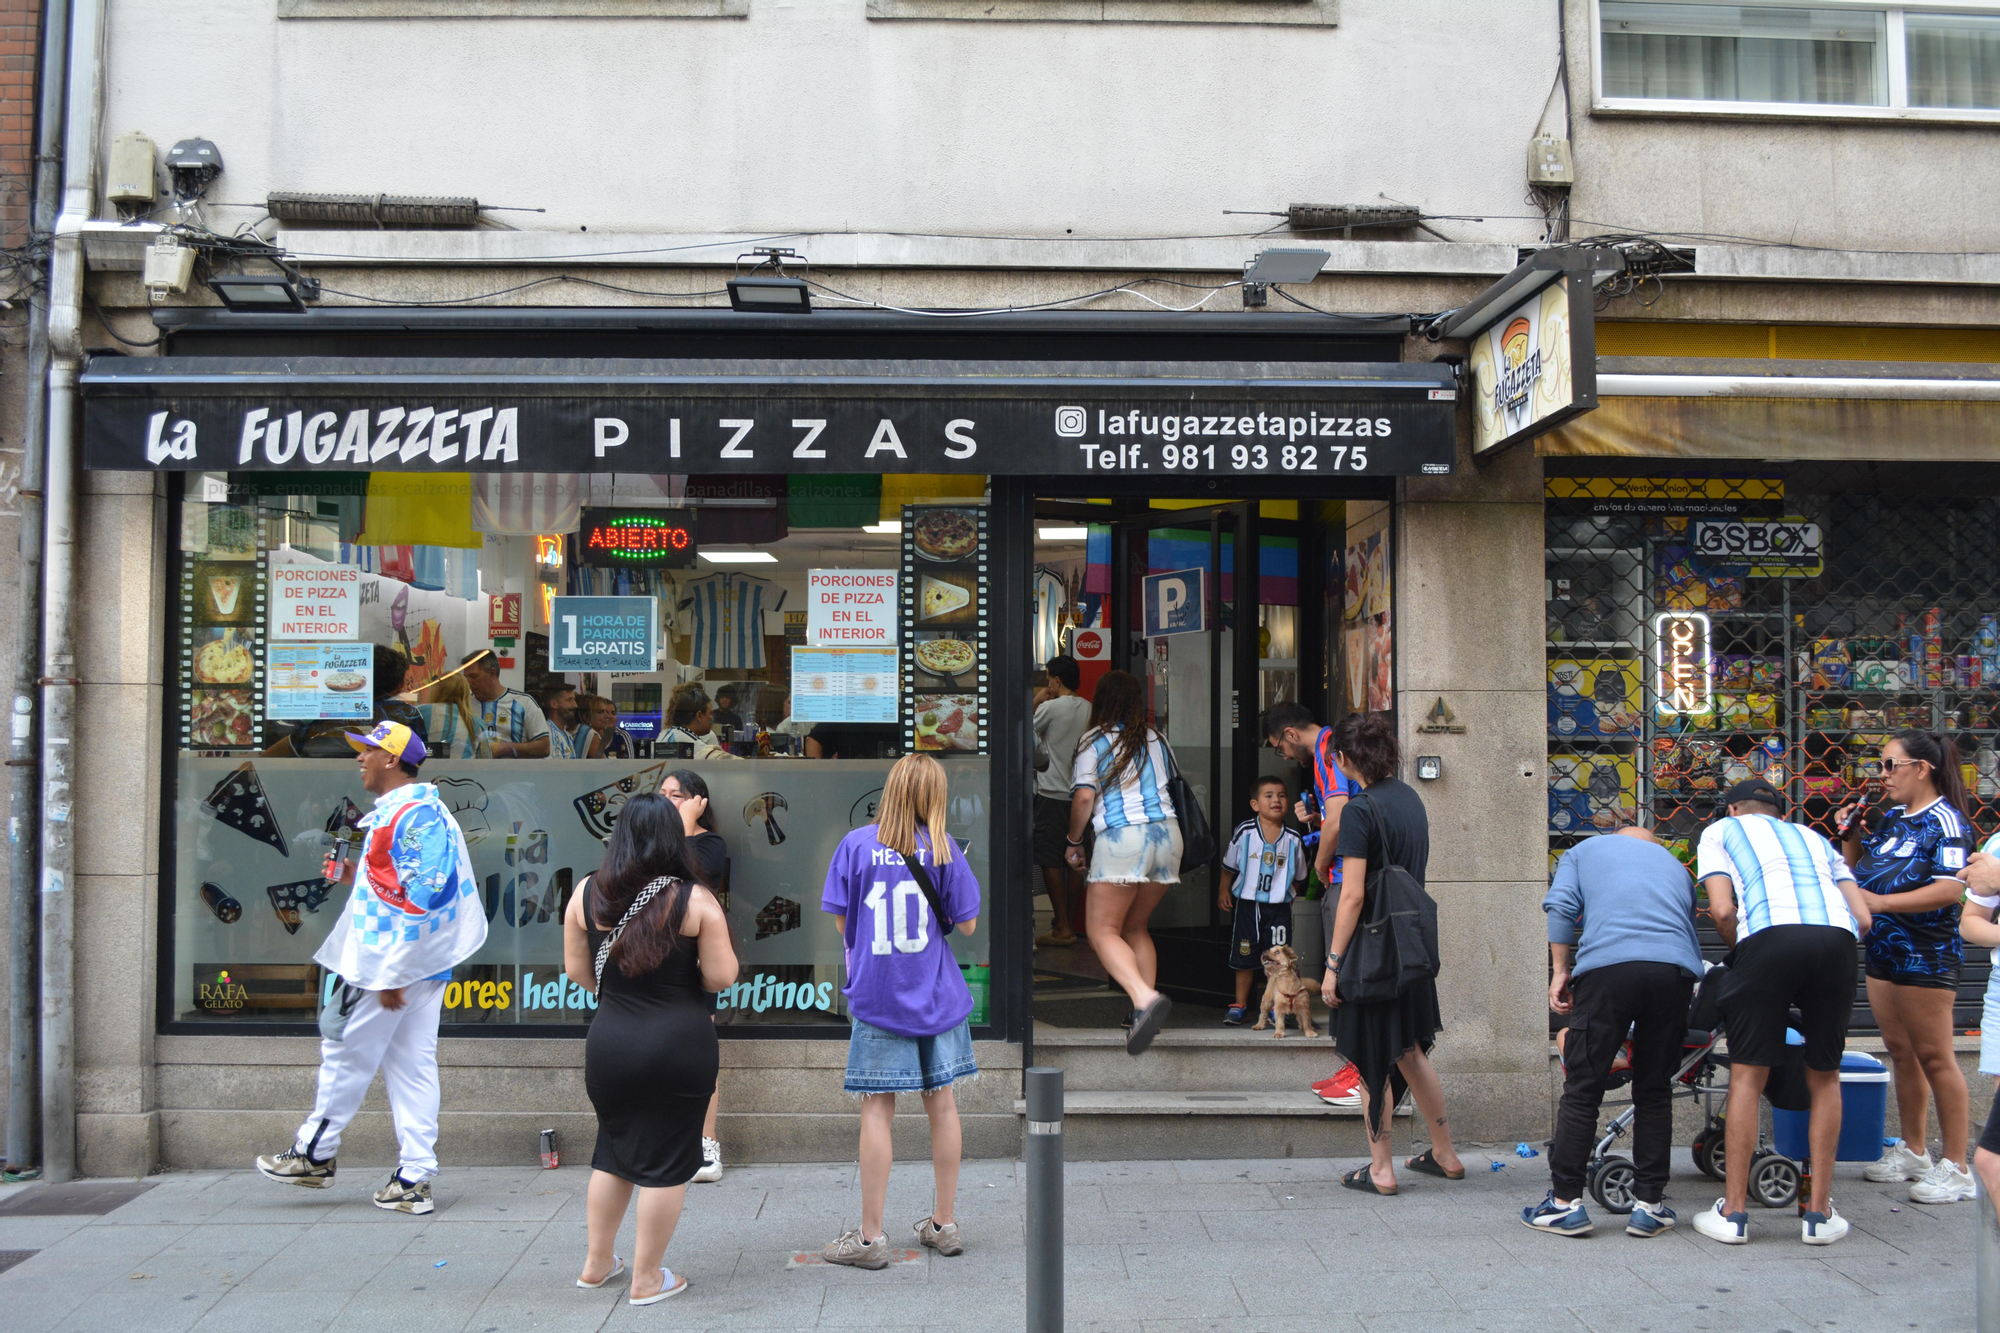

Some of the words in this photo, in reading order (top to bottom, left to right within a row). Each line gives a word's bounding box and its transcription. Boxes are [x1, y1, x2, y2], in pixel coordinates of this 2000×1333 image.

[1494, 346, 1542, 412] FUGAZZETA
[1098, 410, 1392, 442] lafugazzetapizzas
[146, 410, 198, 464] La
[239, 406, 518, 464] FUGAZZETA
[594, 418, 978, 460] PIZZAS
[1080, 444, 1149, 470] Telf.
[1162, 444, 1216, 470] 981
[1231, 445, 1268, 470] 93
[1280, 446, 1318, 470] 82
[1330, 446, 1367, 471] 75
[588, 528, 688, 548] ABIERTO
[275, 570, 358, 581] PORCIONES
[811, 575, 894, 587] PORCIONES
[285, 587, 304, 598] DE
[308, 587, 348, 598] PIZZA
[821, 593, 840, 603] DE
[844, 593, 884, 603] PIZZA
[296, 605, 314, 616] EN
[318, 605, 336, 616] EL
[1159, 578, 1186, 629] P
[832, 611, 851, 622] EN
[856, 611, 873, 622] EL
[282, 622, 348, 634] INTERIOR
[562, 614, 582, 655] 1
[582, 616, 624, 626] HORA
[627, 616, 645, 626] DE
[582, 628, 645, 639] PARKING
[819, 628, 886, 639] INTERIOR
[582, 642, 645, 655] GRATIS
[324, 658, 367, 669] FUGAZZETA
[872, 848, 926, 866] MESI
[864, 880, 929, 956] 10
[1271, 925, 1286, 945] 10
[200, 984, 249, 1000] RAFA
[444, 980, 512, 1010] ores
[204, 1000, 243, 1009] GELATO
